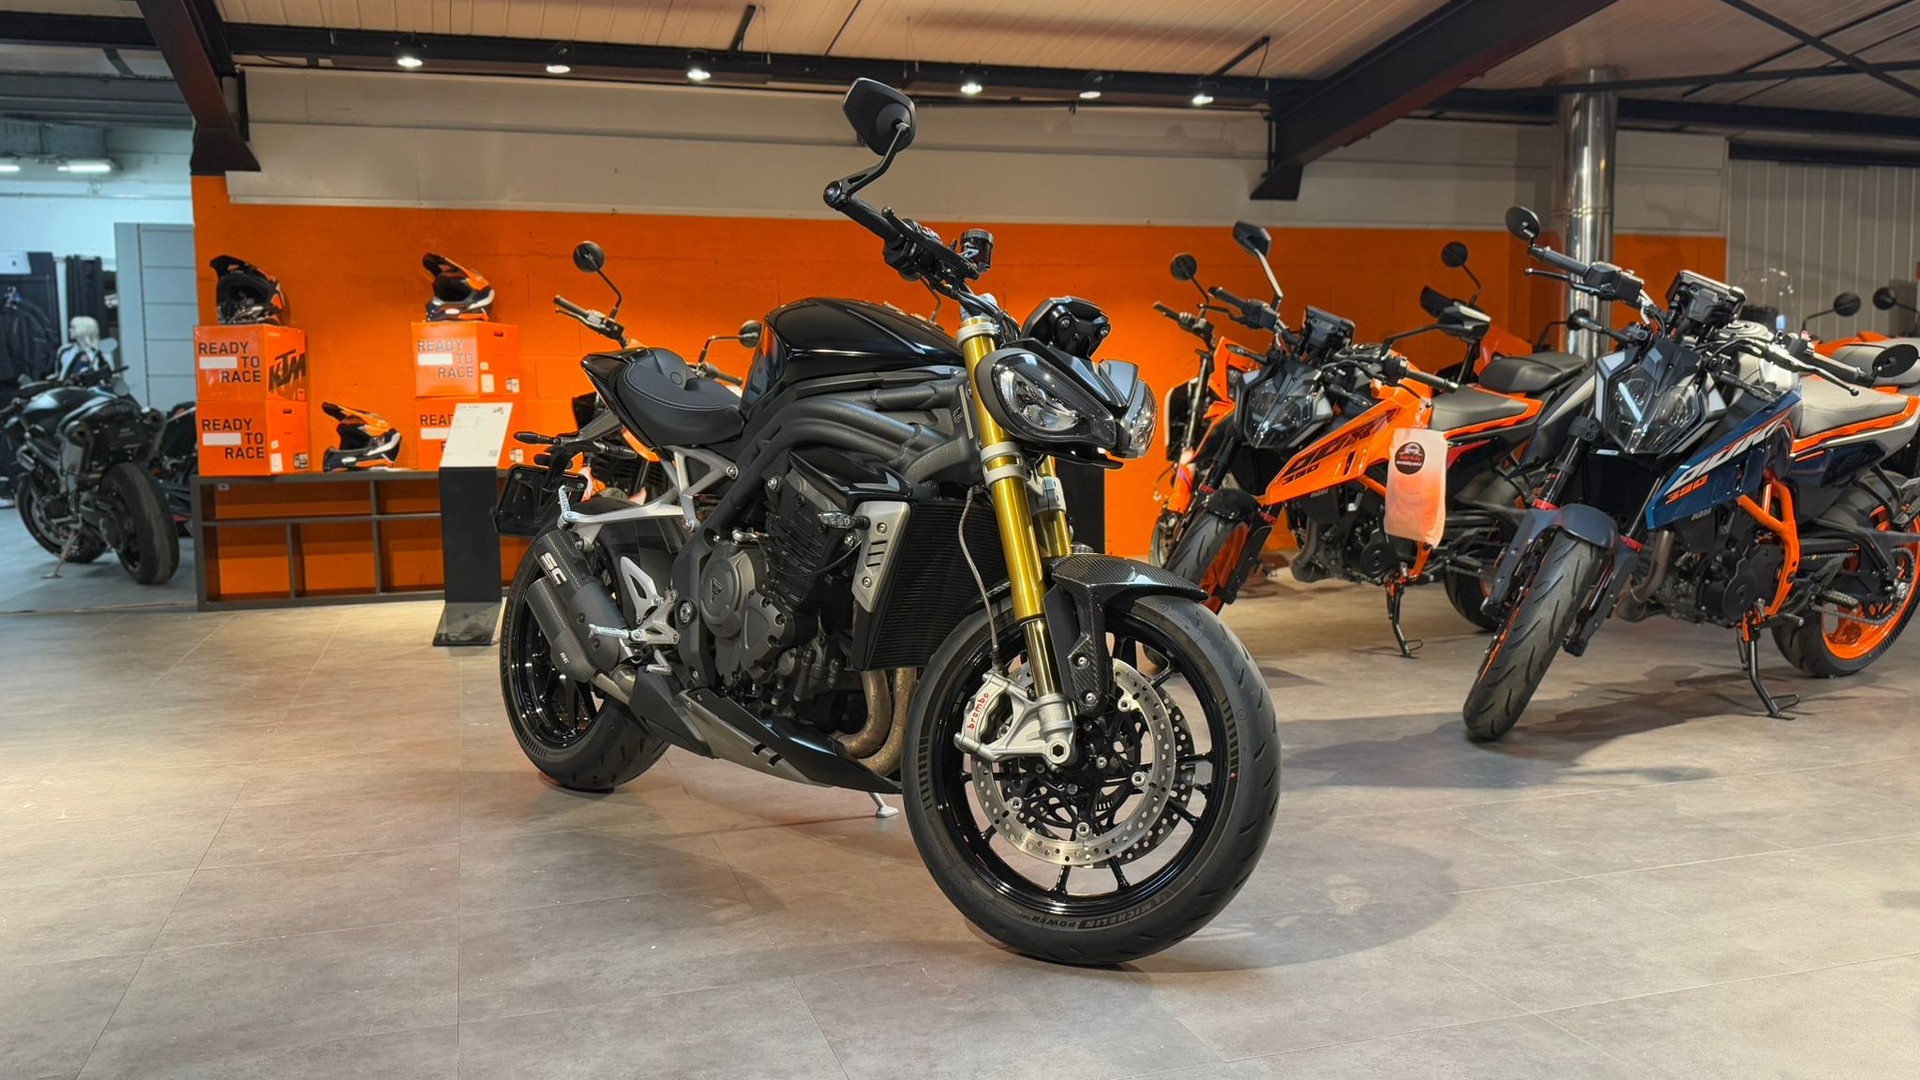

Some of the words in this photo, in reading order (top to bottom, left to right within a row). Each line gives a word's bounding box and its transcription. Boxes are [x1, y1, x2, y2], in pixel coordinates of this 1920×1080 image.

[198, 341, 249, 355] READY
[417, 339, 463, 352] READY
[240, 355, 260, 368] TO
[456, 353, 473, 364] TO
[221, 370, 261, 383] RACE
[268, 349, 307, 391] KTM
[438, 366, 474, 378] RACE
[201, 418, 253, 431] READY
[244, 432, 264, 445] TO
[224, 447, 265, 459] RACE
[1664, 473, 1709, 505] 390
[539, 552, 568, 585] SC
[966, 692, 990, 730] brembo
[1031, 915, 1076, 928] POWER
[1084, 902, 1152, 928] MICHELIN
